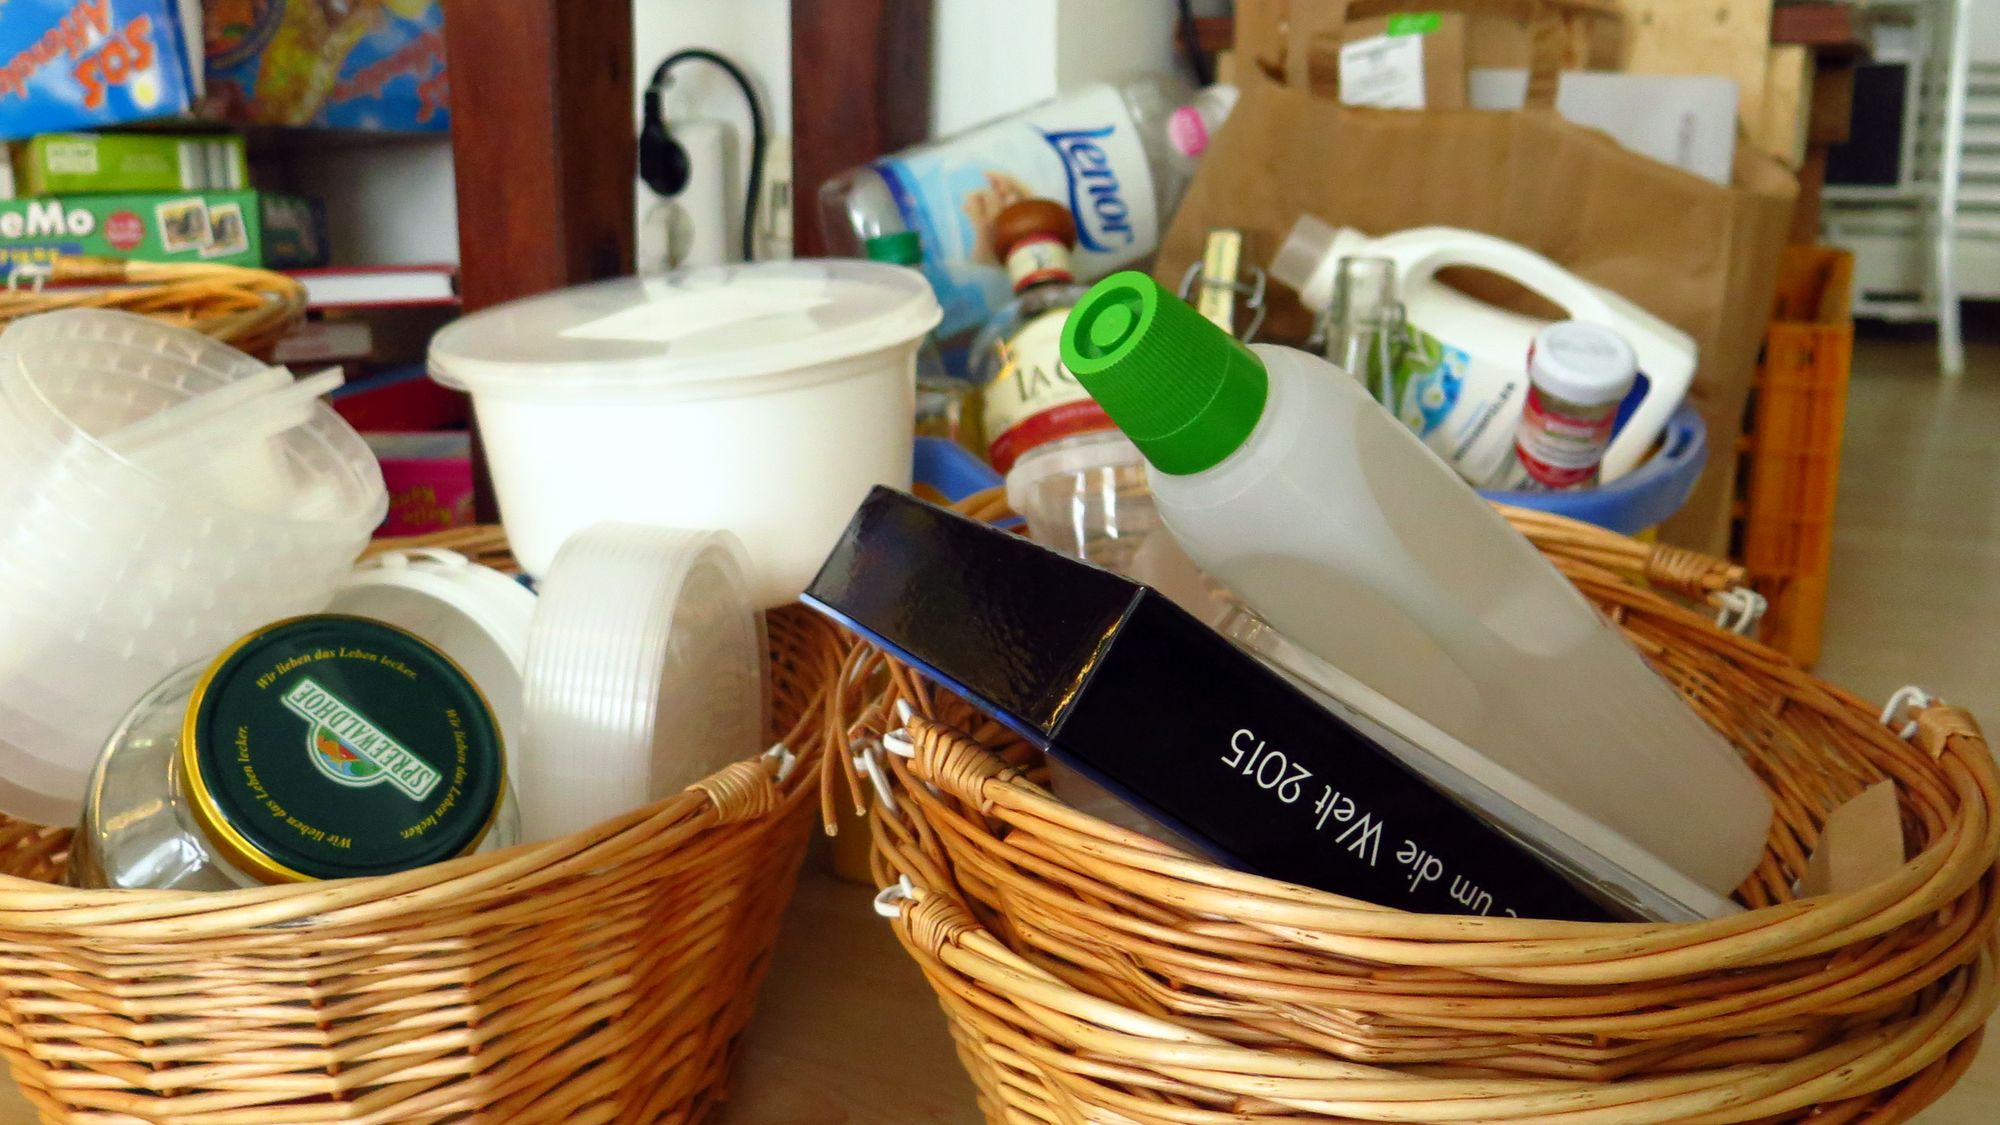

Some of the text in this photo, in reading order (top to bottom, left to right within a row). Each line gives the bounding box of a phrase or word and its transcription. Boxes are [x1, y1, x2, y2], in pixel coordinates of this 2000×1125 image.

[71, 14, 156, 111] SOS
[1026, 123, 1135, 254] Lenor
[255, 670, 278, 690] Wir
[275, 653, 312, 676] lieben
[313, 649, 337, 661] das
[338, 647, 378, 662] Leben
[291, 685, 433, 788] SPREEWALDHOF
[243, 765, 270, 801] Leben
[454, 765, 468, 786] das
[264, 799, 288, 818] das
[1220, 728, 1494, 917] um die Welt 2015
[285, 816, 326, 842] lieben
[326, 834, 353, 849] Wir
